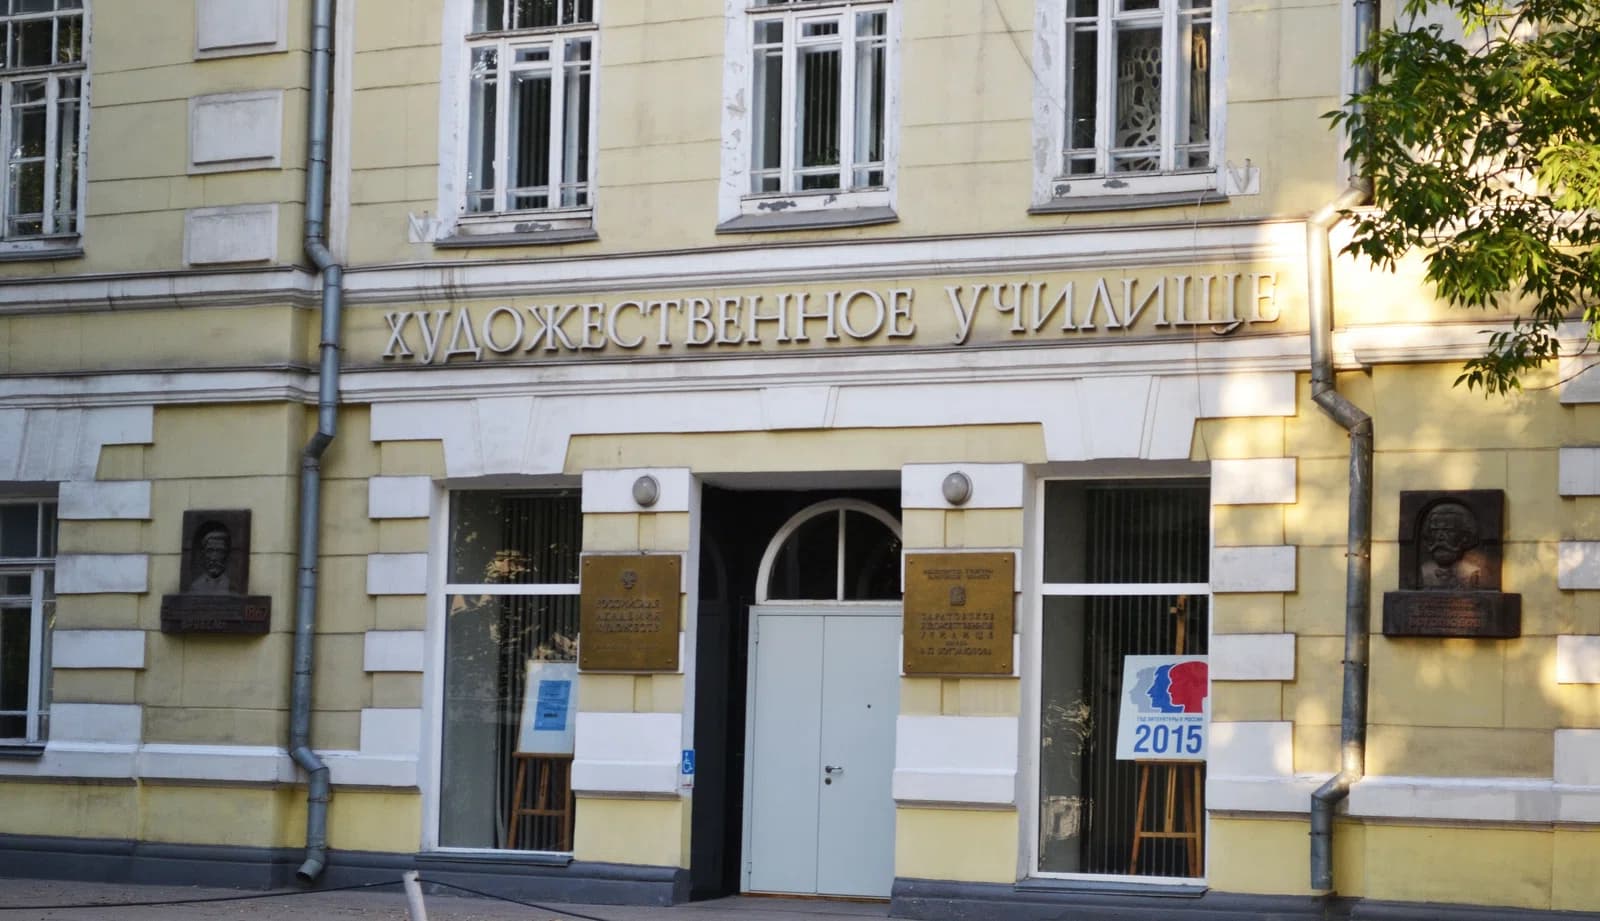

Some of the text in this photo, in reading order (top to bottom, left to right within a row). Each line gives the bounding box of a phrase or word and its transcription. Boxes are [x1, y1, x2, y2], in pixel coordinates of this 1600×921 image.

[384, 271, 1281, 365] ХУДОЖЕСТВЕННОЕ УЧИЛИЩЕ
[1134, 724, 1202, 754] 2015
